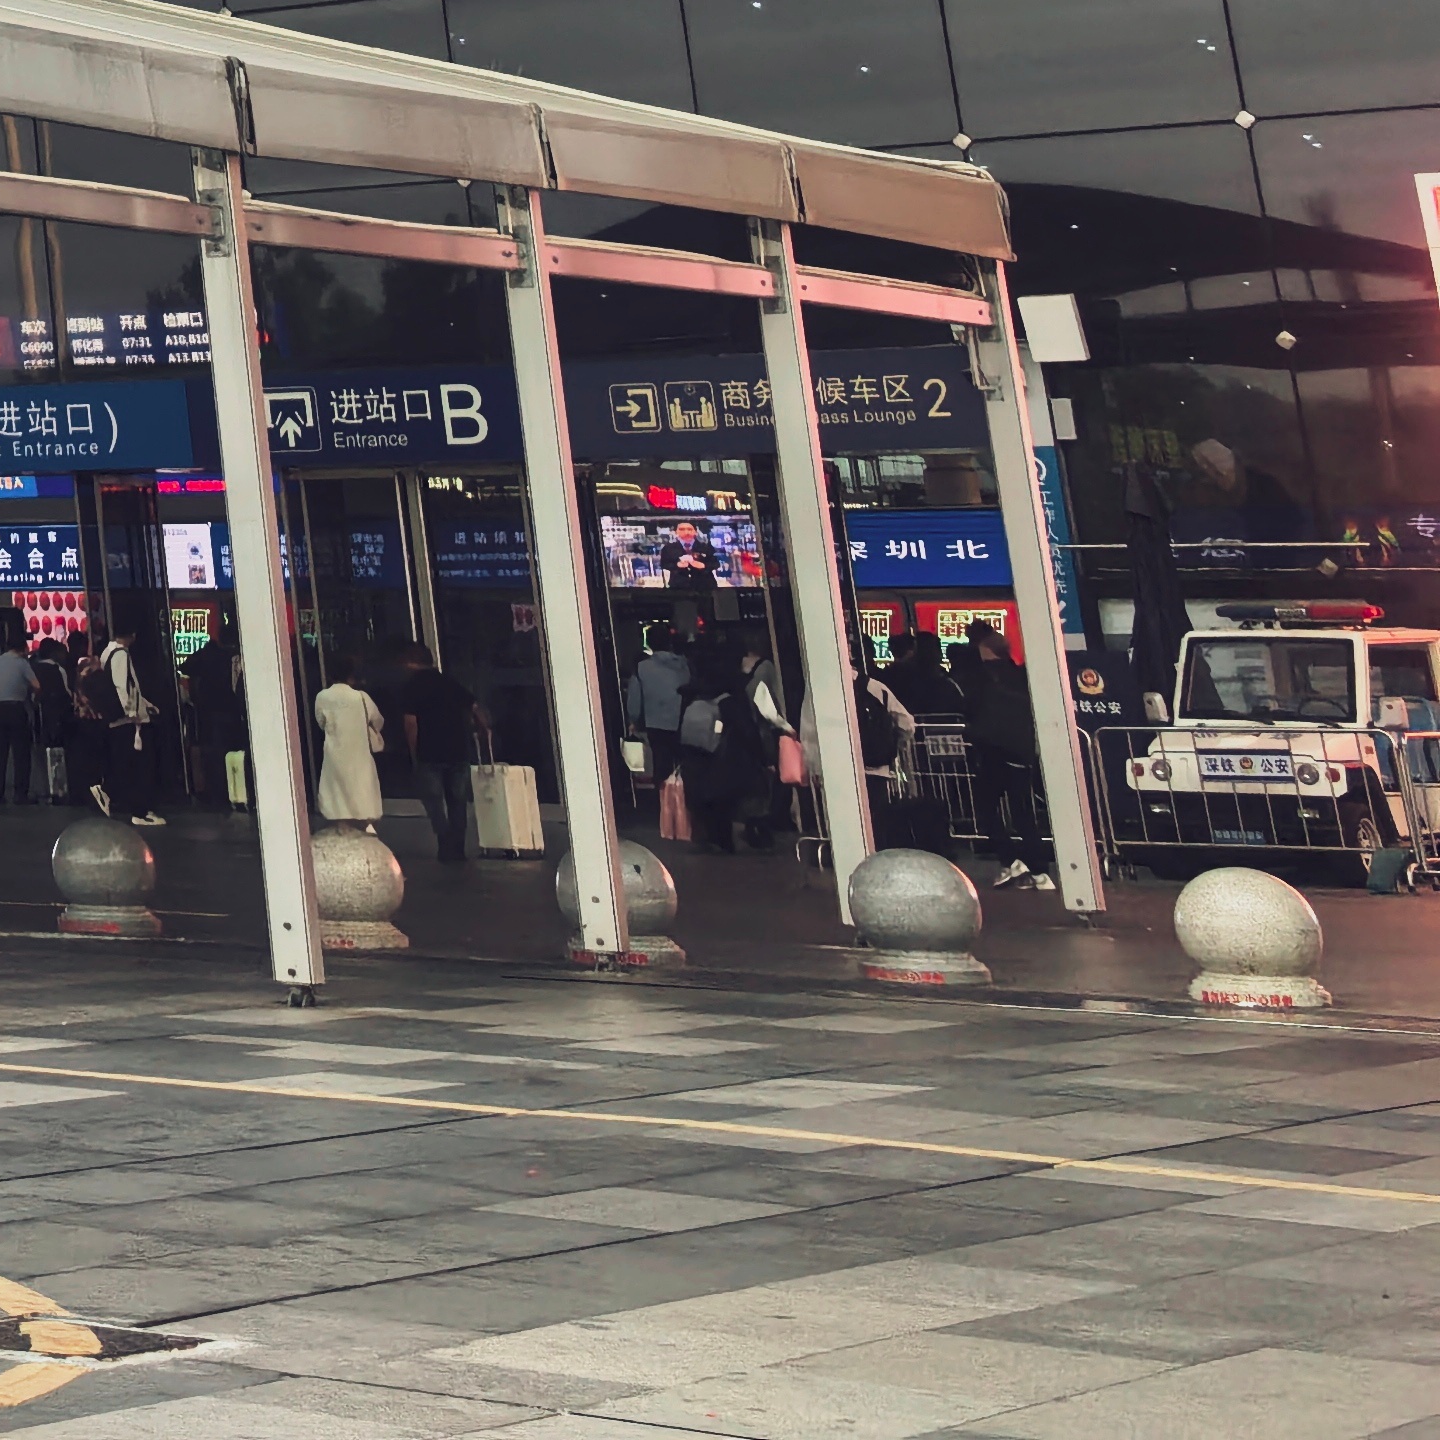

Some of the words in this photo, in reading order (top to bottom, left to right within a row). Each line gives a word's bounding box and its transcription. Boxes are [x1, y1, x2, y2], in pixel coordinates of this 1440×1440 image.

[20, 320, 46, 334] 车次
[119, 315, 146, 330] 开点
[163, 312, 203, 327] 检票口
[923, 378, 952, 418] 2
[330, 387, 432, 425] 进站口
[439, 383, 489, 445] B
[854, 410, 917, 426] Lounge
[13, 441, 99, 457] Entrance
[333, 431, 408, 448] Entrance
[1205, 756, 1235, 773] 深铁
[1261, 757, 1290, 775] 公安
